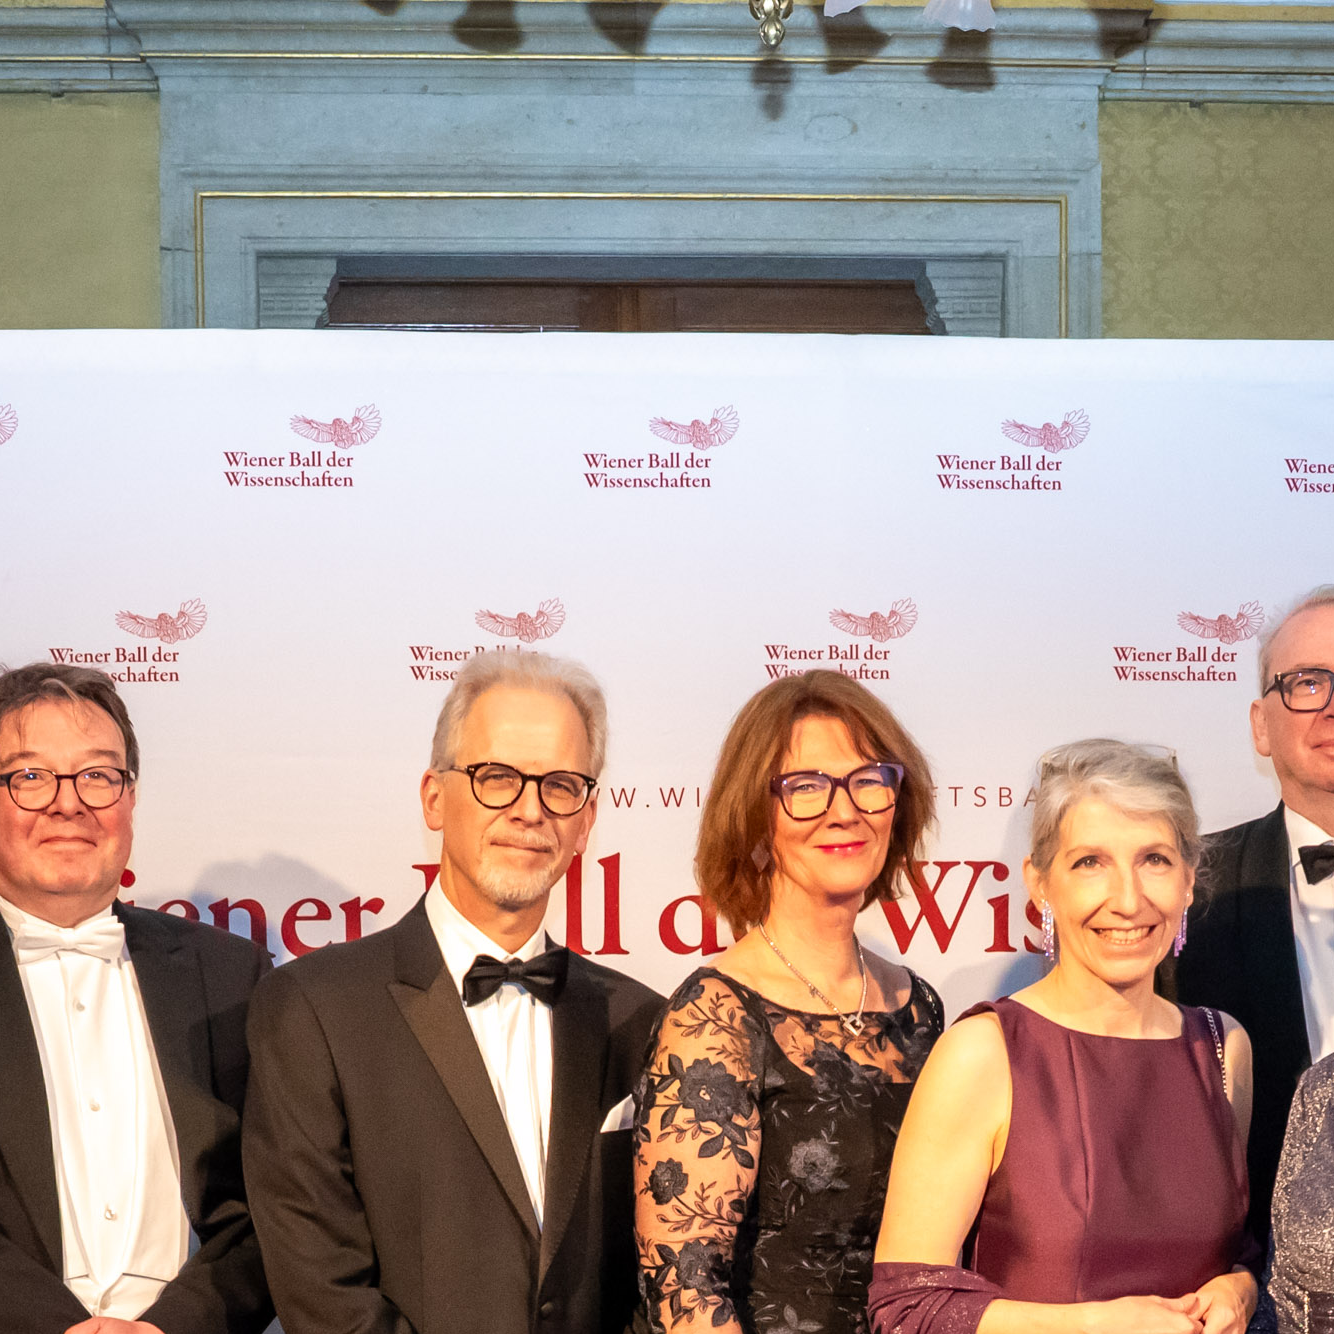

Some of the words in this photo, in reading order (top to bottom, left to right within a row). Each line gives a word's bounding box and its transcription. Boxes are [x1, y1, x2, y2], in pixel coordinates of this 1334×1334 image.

[224, 451, 284, 467] Wiener
[290, 451, 321, 467] Ball
[326, 451, 354, 467] der
[584, 453, 643, 468] Wiener
[649, 452, 679, 468] Ball
[685, 452, 711, 468] der
[937, 455, 995, 470] Wiener
[1001, 455, 1031, 470] Ball
[1036, 455, 1062, 471] der
[224, 471, 354, 487] Wissenschaften
[584, 472, 711, 488] Wissenschaften
[937, 474, 1062, 490] Wissenschaften
[49, 648, 110, 663] Wiener
[115, 647, 148, 663] Ball
[152, 648, 179, 663] der
[409, 646, 470, 661] Wiener
[765, 645, 824, 660] Wiener
[828, 644, 859, 660] Ball
[864, 644, 890, 660] der
[1113, 646, 1172, 662] Wiener
[1176, 646, 1207, 662] Ball
[1211, 646, 1237, 662] der
[110, 666, 180, 681] schaften
[1113, 665, 1237, 681] Wissenschaften
